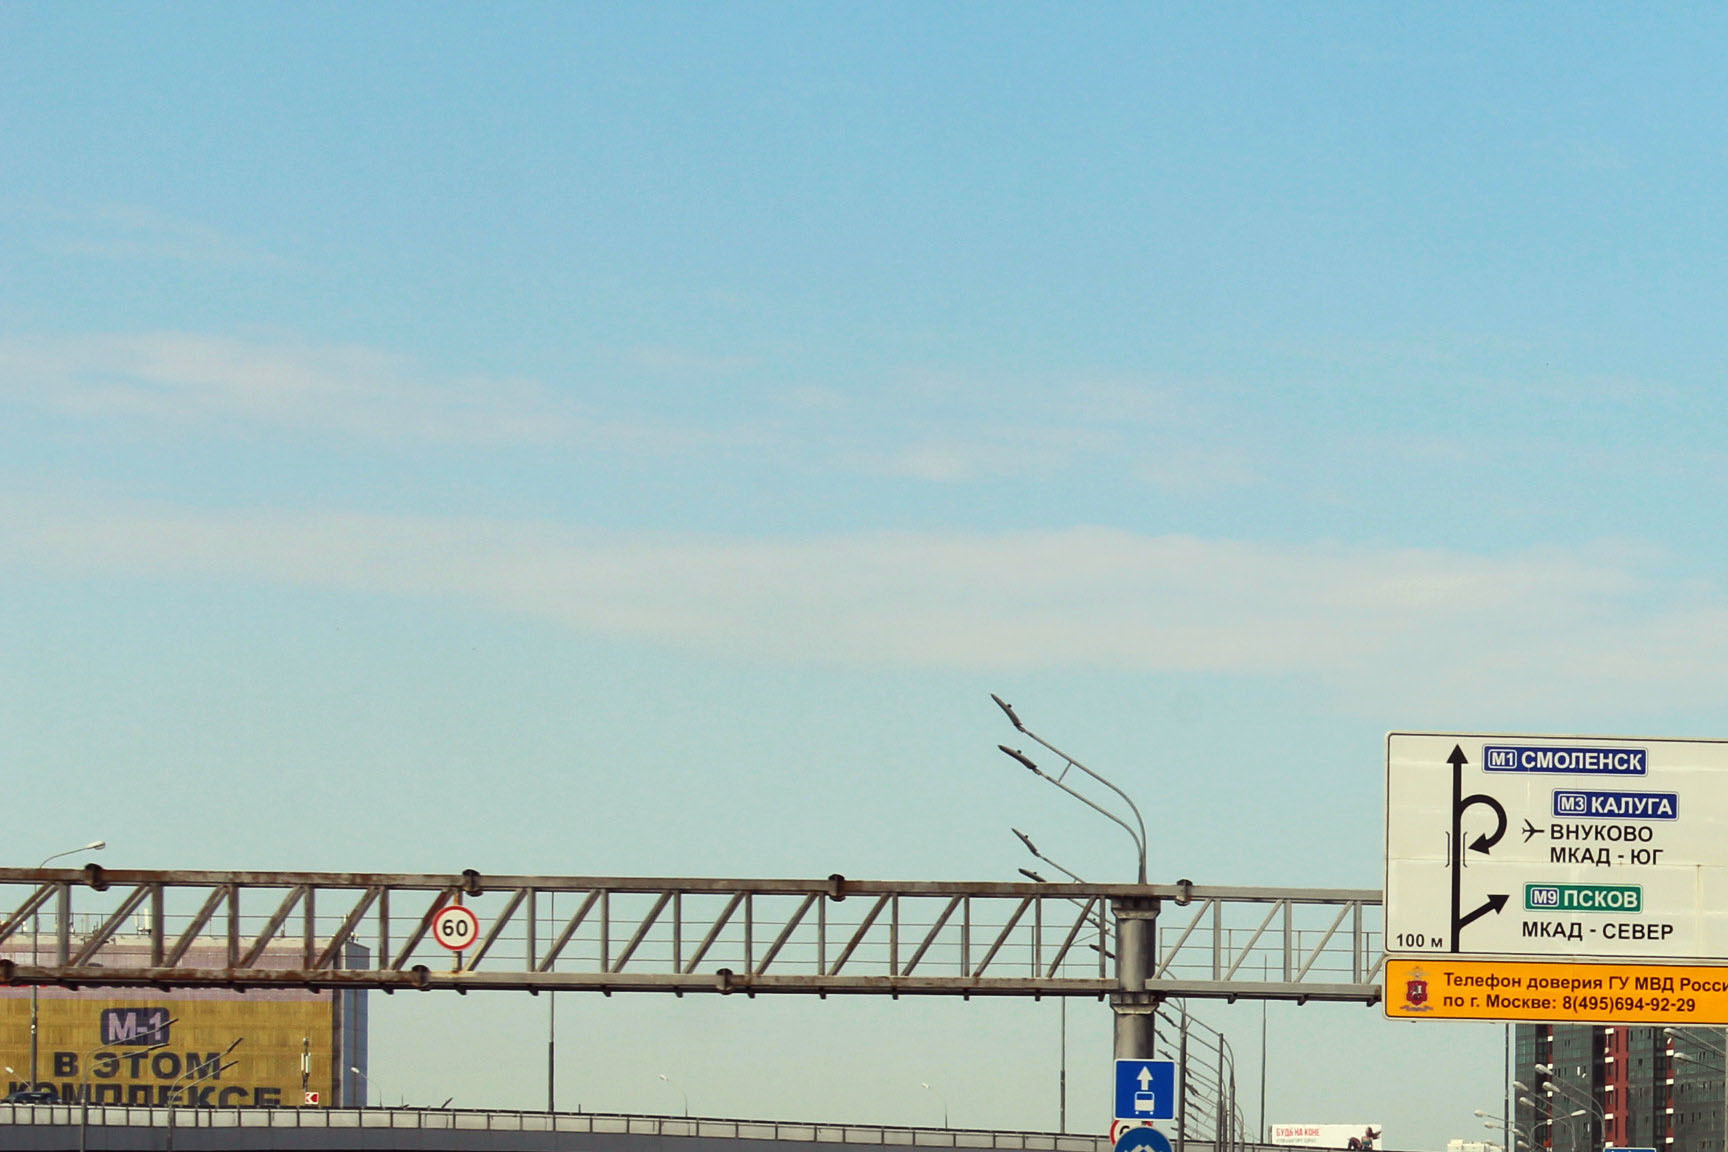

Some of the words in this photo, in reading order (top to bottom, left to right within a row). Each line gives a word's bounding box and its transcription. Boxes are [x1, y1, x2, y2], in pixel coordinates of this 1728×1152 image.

[1492, 752, 1515, 767] М1
[1522, 751, 1642, 770] СМОЛЕНСК
[1561, 796, 1585, 811] М3
[1591, 797, 1673, 815] КАЛУГА
[1551, 824, 1653, 842] ВНУКОВО
[1550, 847, 1611, 867] МКАД
[1630, 849, 1664, 865] ЮГ
[1534, 890, 1558, 904] М9
[1564, 890, 1639, 908] ПСКОВ
[442, 919, 468, 937] 60
[1522, 922, 1583, 941] МКАД
[1602, 923, 1674, 940] СЕВЕР
[1396, 934, 1425, 948] 100
[1431, 938, 1443, 948] м
[1443, 972, 1522, 990] Телефон
[1526, 976, 1603, 993] доверия
[1609, 977, 1629, 991] ГУ
[1635, 977, 1675, 993] МВД
[1443, 996, 1464, 1007] по
[1470, 998, 1480, 1008] г.
[1486, 996, 1557, 1010] Москве:
[1562, 997, 1697, 1013] 8(495)694-92-29
[107, 1011, 162, 1041] М-1
[54, 1051, 79, 1079] В
[93, 1051, 221, 1080] ЭТОМ
